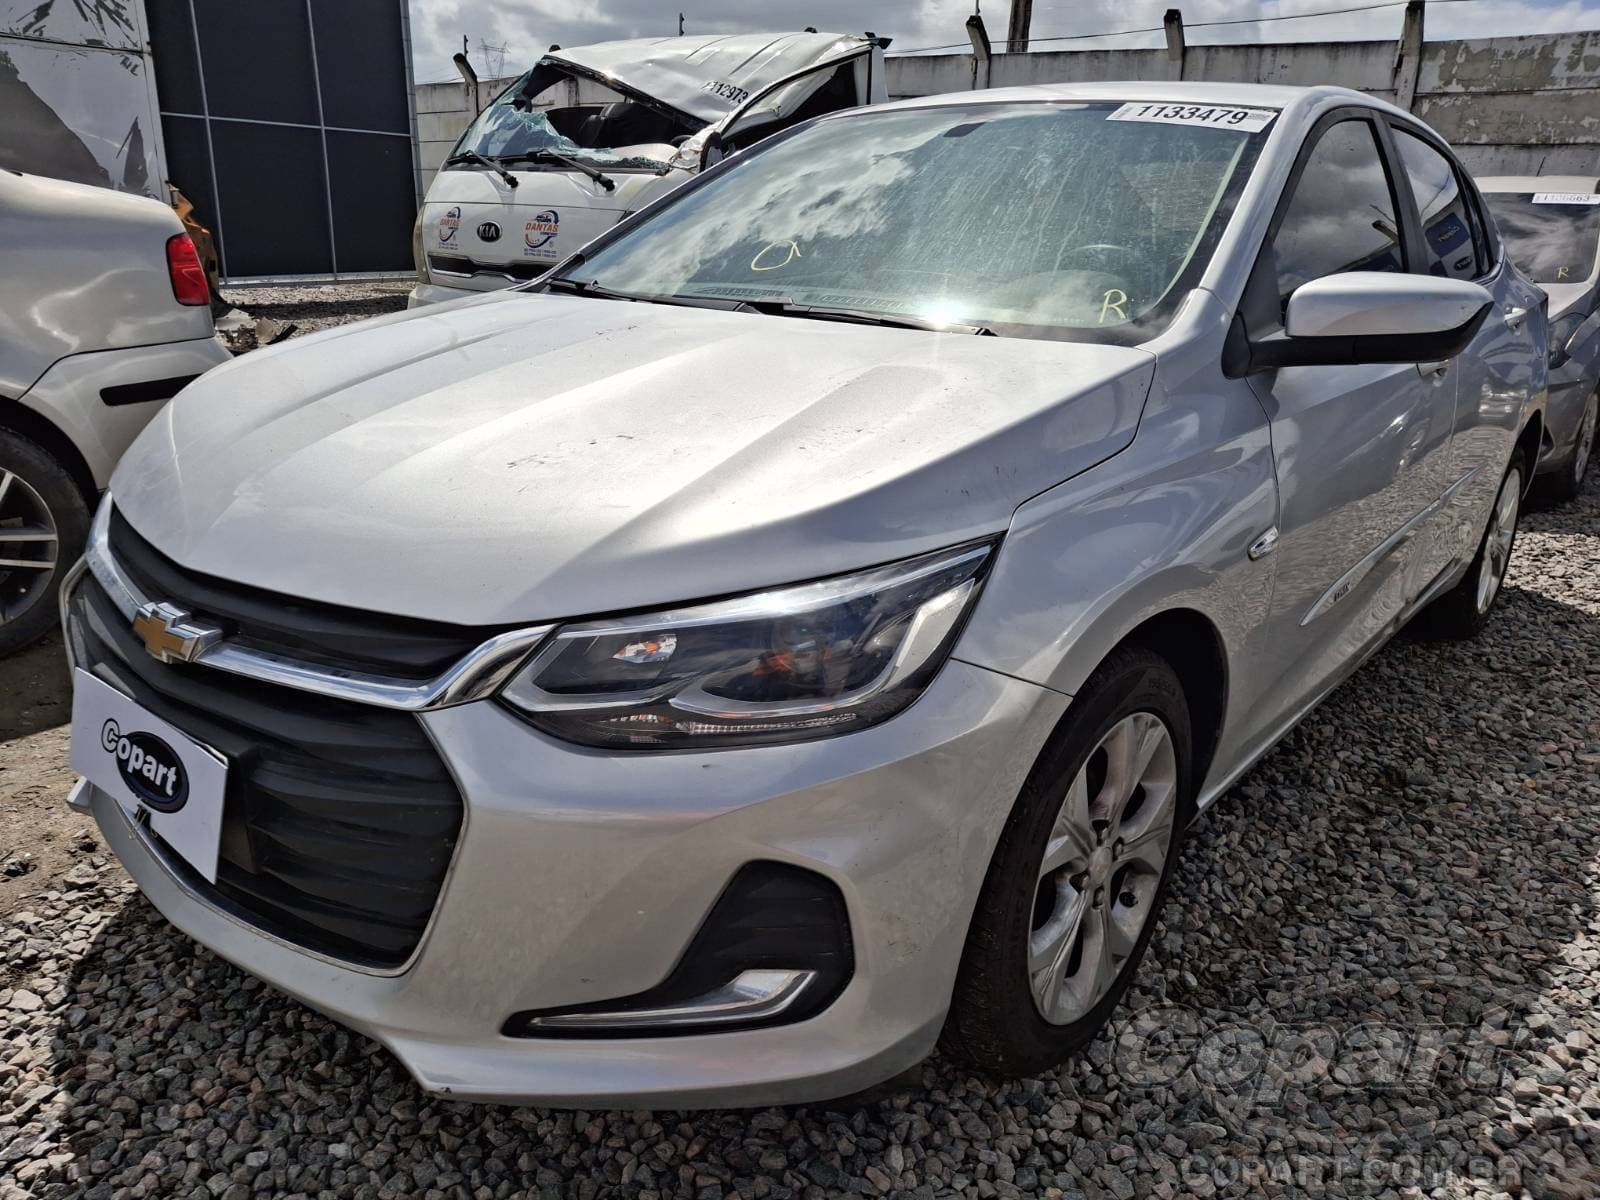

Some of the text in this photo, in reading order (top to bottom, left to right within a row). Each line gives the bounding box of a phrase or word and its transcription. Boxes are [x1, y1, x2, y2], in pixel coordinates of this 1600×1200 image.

[1136, 104, 1249, 125] 1133479
[479, 225, 497, 238] KIA
[525, 222, 560, 233] DANTAS
[1556, 266, 1569, 279] R
[1099, 288, 1128, 324] R
[101, 717, 178, 797] Copart
